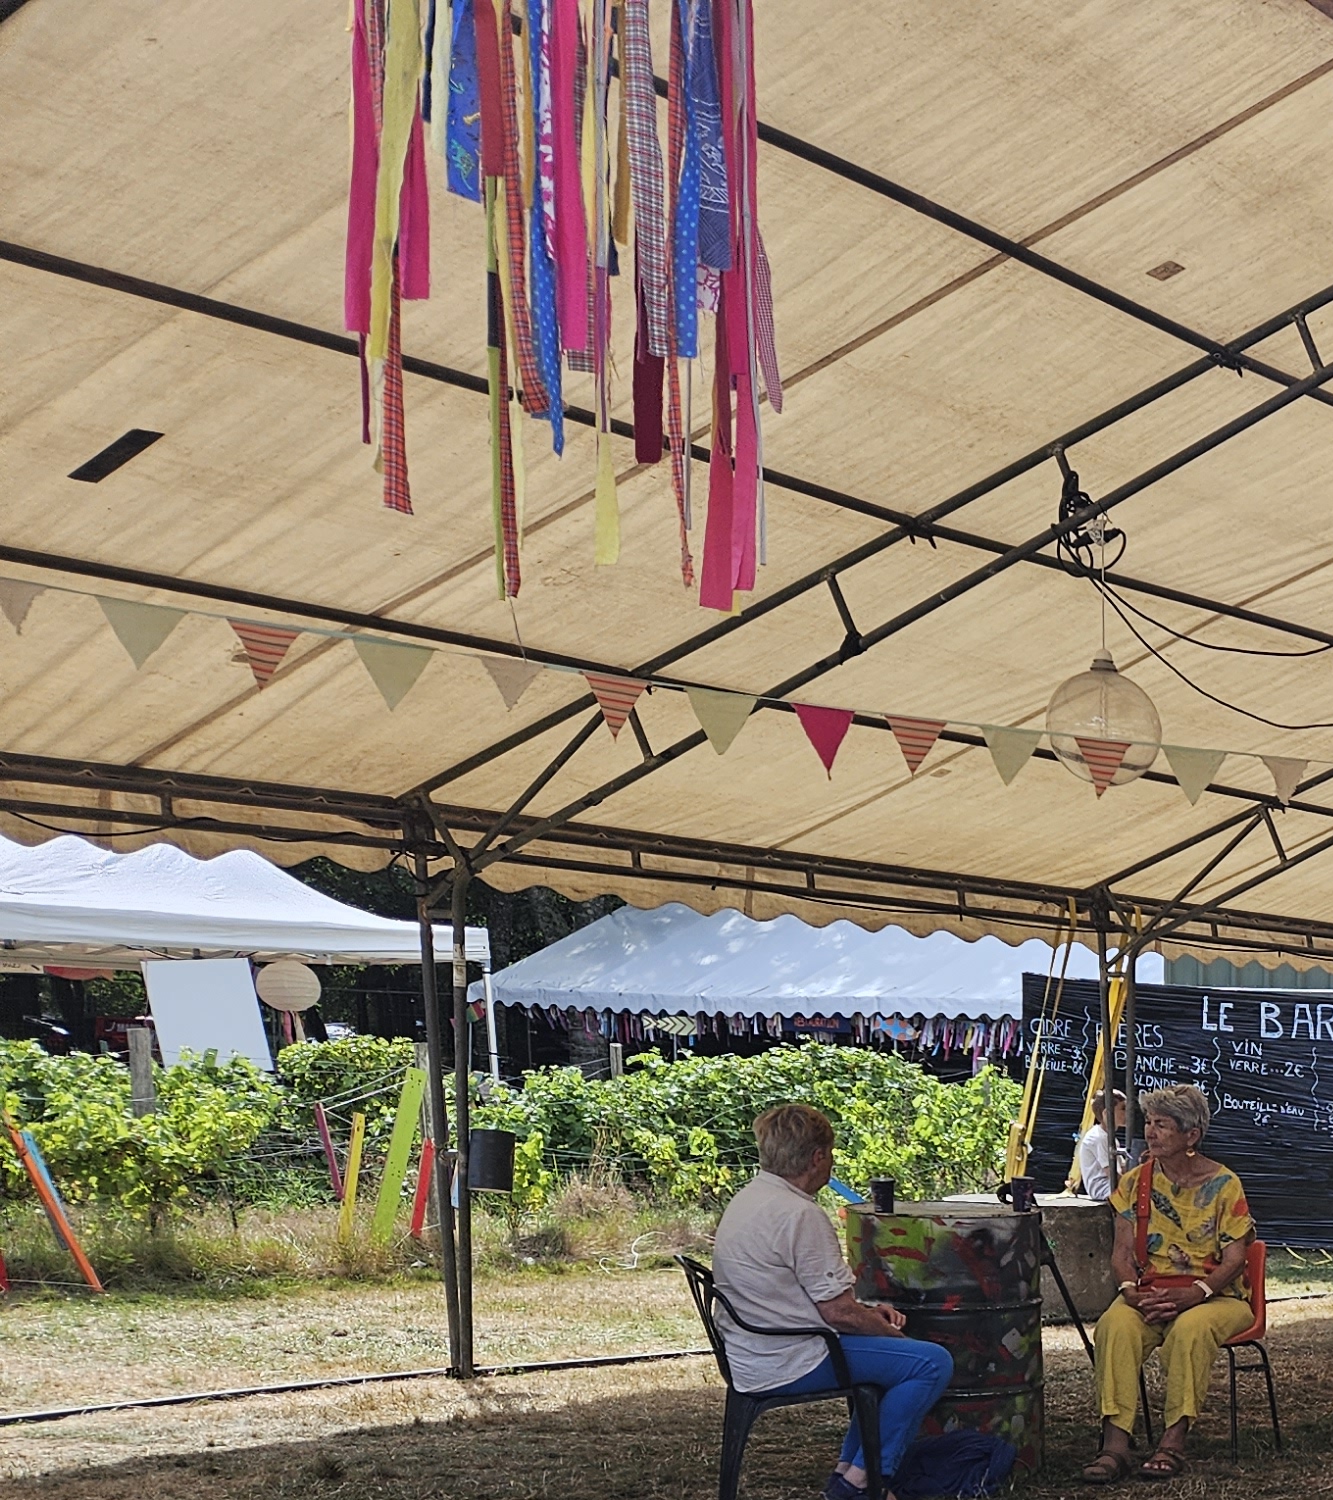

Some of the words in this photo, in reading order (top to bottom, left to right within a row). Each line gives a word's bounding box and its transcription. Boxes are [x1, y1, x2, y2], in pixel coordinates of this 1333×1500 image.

[1202, 996, 1234, 1032] LE
[1030, 1018, 1073, 1038] CIDRE
[1096, 1016, 1164, 1048] ÈRES
[1026, 1042, 1061, 1055] VRRE
[1025, 1054, 1067, 1072] BUEILLE
[1114, 1050, 1177, 1074] BANCHE
